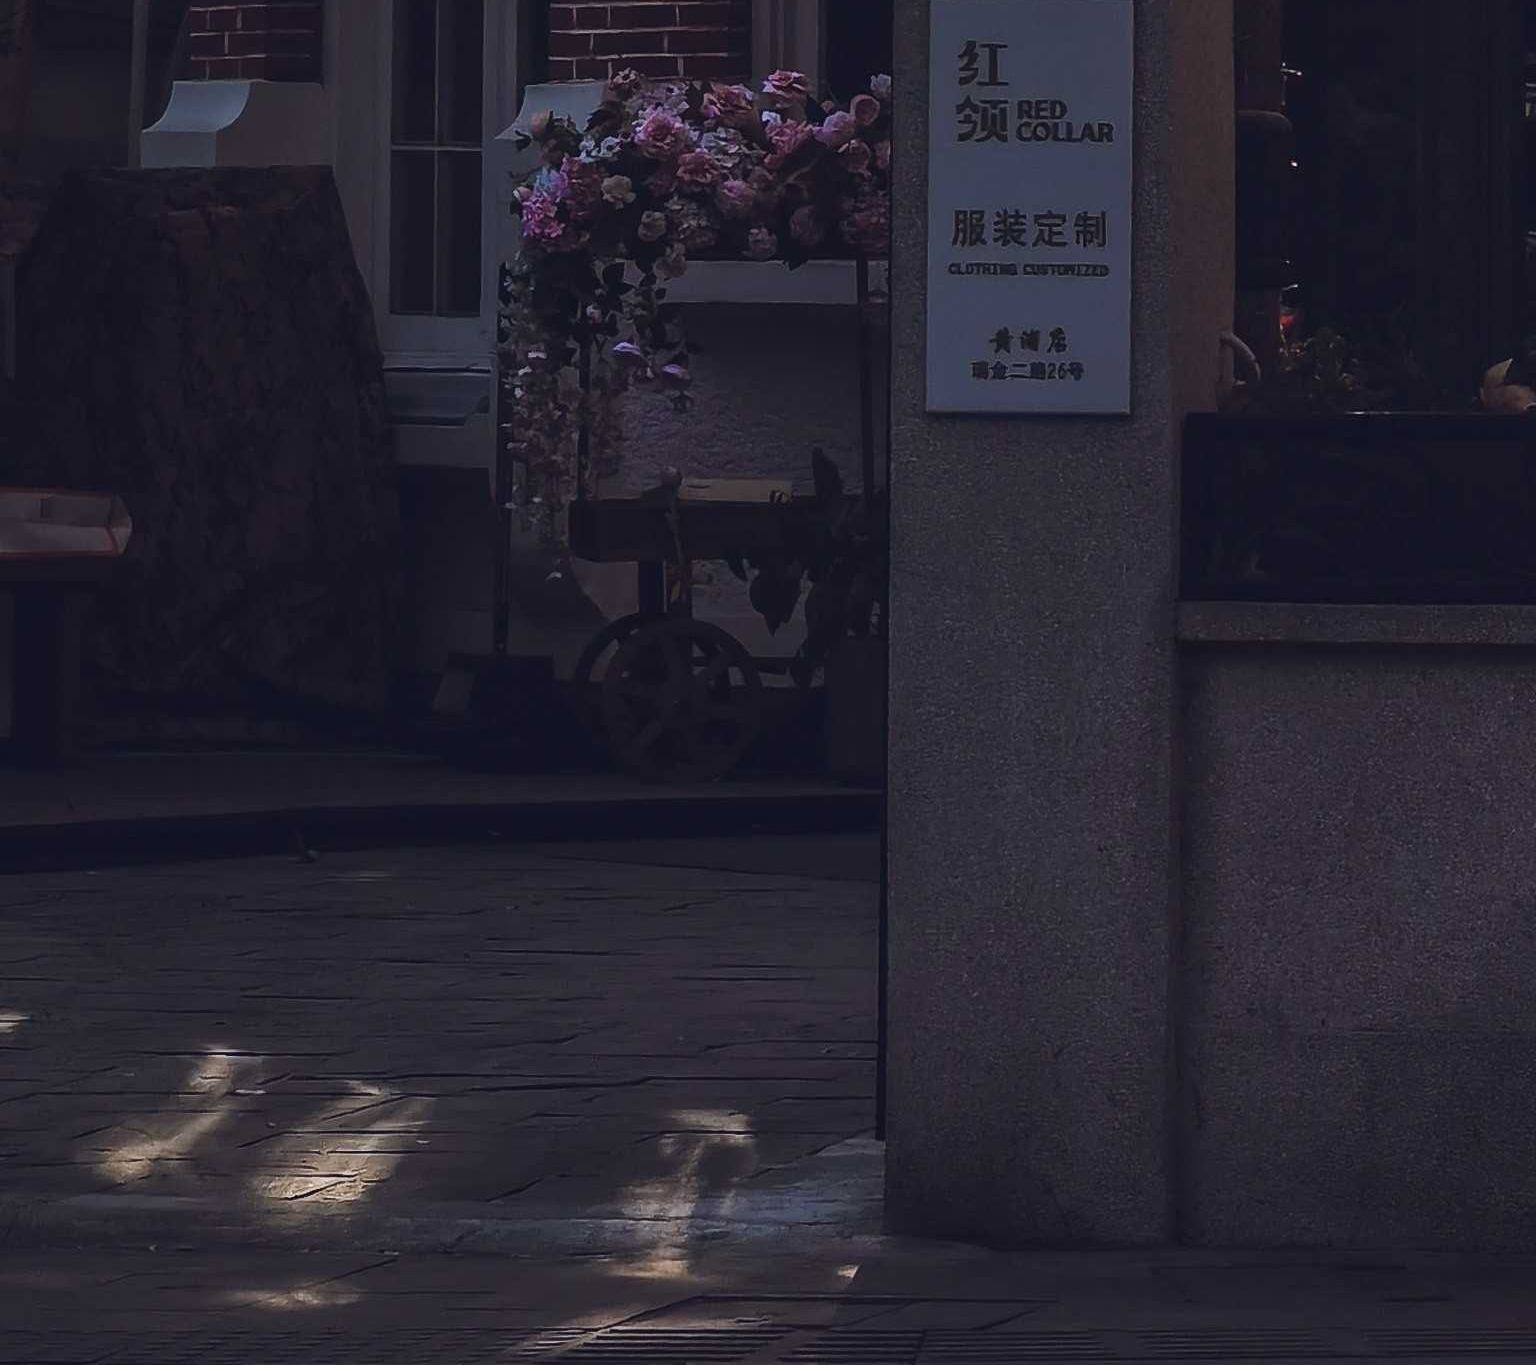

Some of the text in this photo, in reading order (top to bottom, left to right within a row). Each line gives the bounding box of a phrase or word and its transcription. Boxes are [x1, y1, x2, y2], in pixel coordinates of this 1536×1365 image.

[1017, 100, 1067, 119] RED
[1016, 121, 1114, 142] COLLAR
[952, 208, 1107, 247] 服装定制
